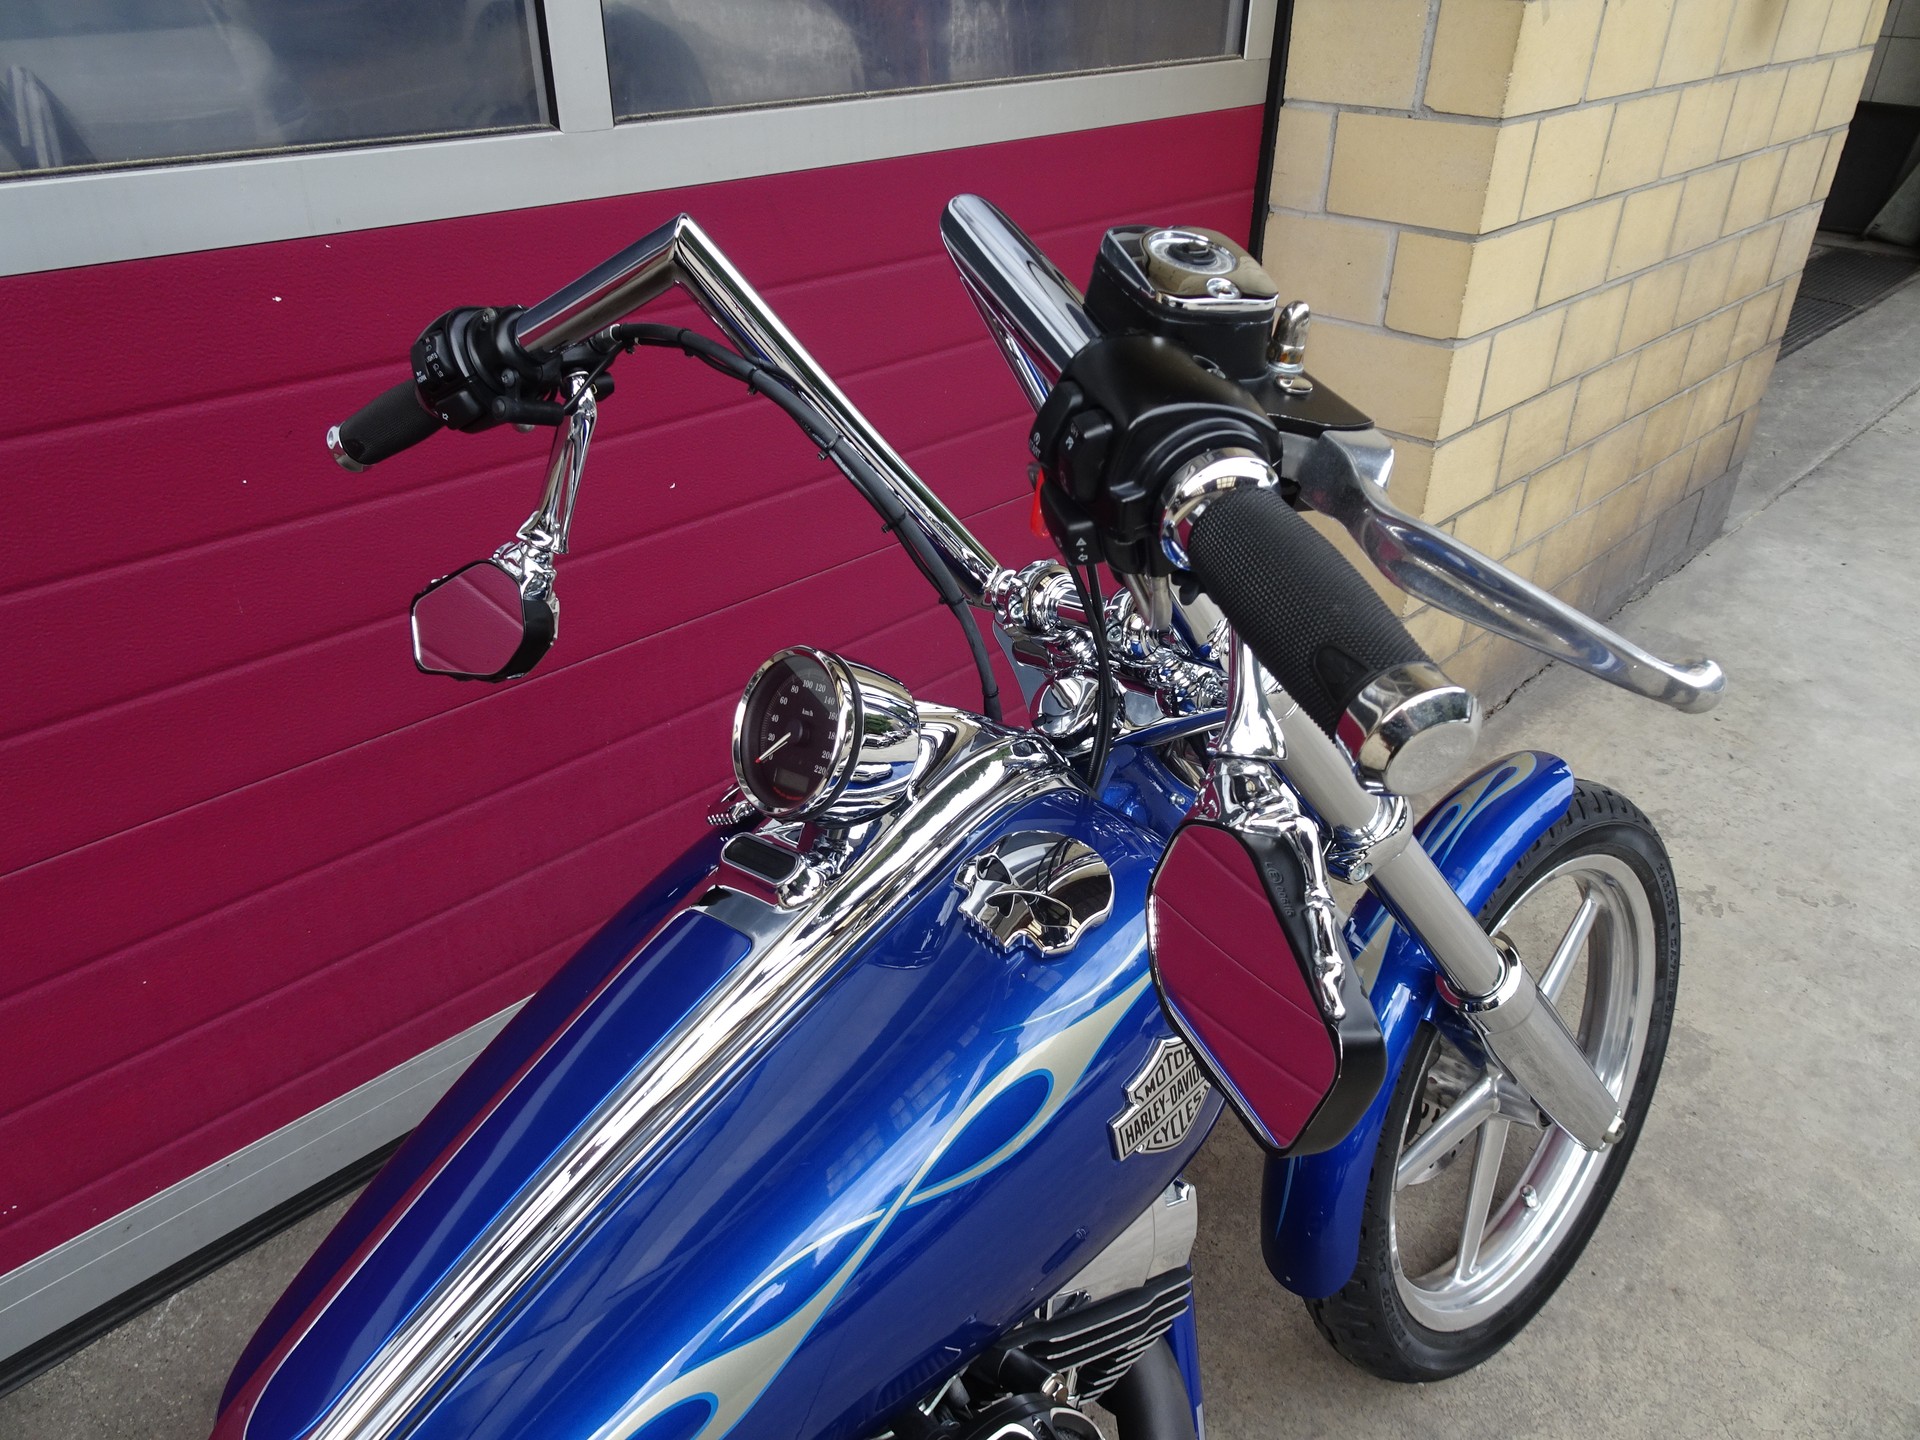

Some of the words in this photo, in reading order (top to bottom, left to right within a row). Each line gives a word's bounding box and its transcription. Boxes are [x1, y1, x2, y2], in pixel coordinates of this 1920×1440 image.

[802, 679, 813, 689] 100
[815, 683, 826, 693] 120
[790, 685, 799, 694] 80
[779, 696, 788, 705] 60
[824, 695, 835, 705] 140
[771, 714, 779, 723] 40
[768, 732, 775, 741] 20
[828, 731, 836, 740] 18
[814, 764, 826, 775] 220
[1125, 1065, 1200, 1148] HARLEY-DAVID
[1153, 1089, 1202, 1144] CYCLES
